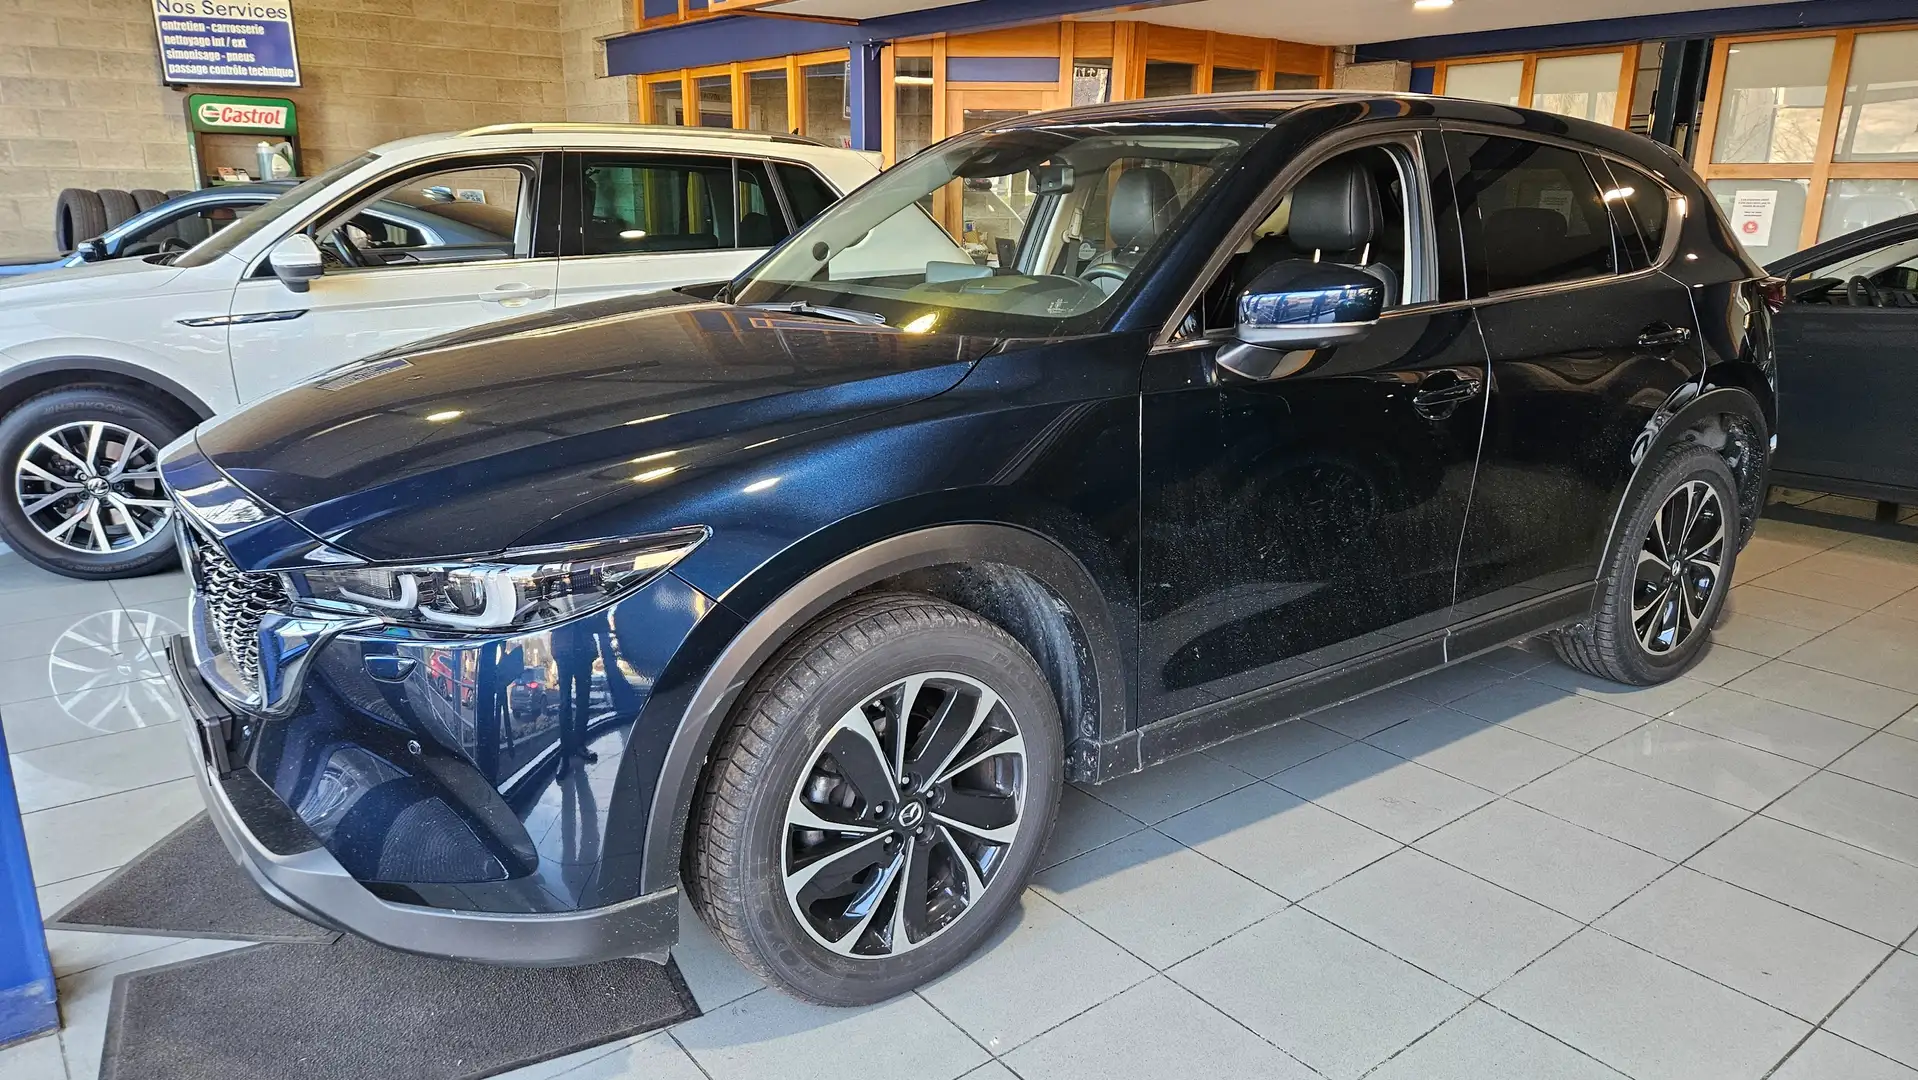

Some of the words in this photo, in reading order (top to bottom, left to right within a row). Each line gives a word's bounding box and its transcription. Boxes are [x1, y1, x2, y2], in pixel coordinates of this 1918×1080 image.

[156, 0, 196, 14] Nos
[202, 0, 288, 19] Services
[161, 20, 206, 32] entretien
[211, 23, 265, 35] carrosserie
[163, 35, 211, 47] nettoyage
[211, 35, 226, 47] int
[231, 38, 248, 49] ext
[166, 48, 221, 62] simonisage
[226, 52, 256, 63] pneus
[168, 63, 209, 75] passage
[208, 64, 248, 76] contrôle
[247, 65, 294, 79] technique
[221, 107, 281, 125] Castrol
